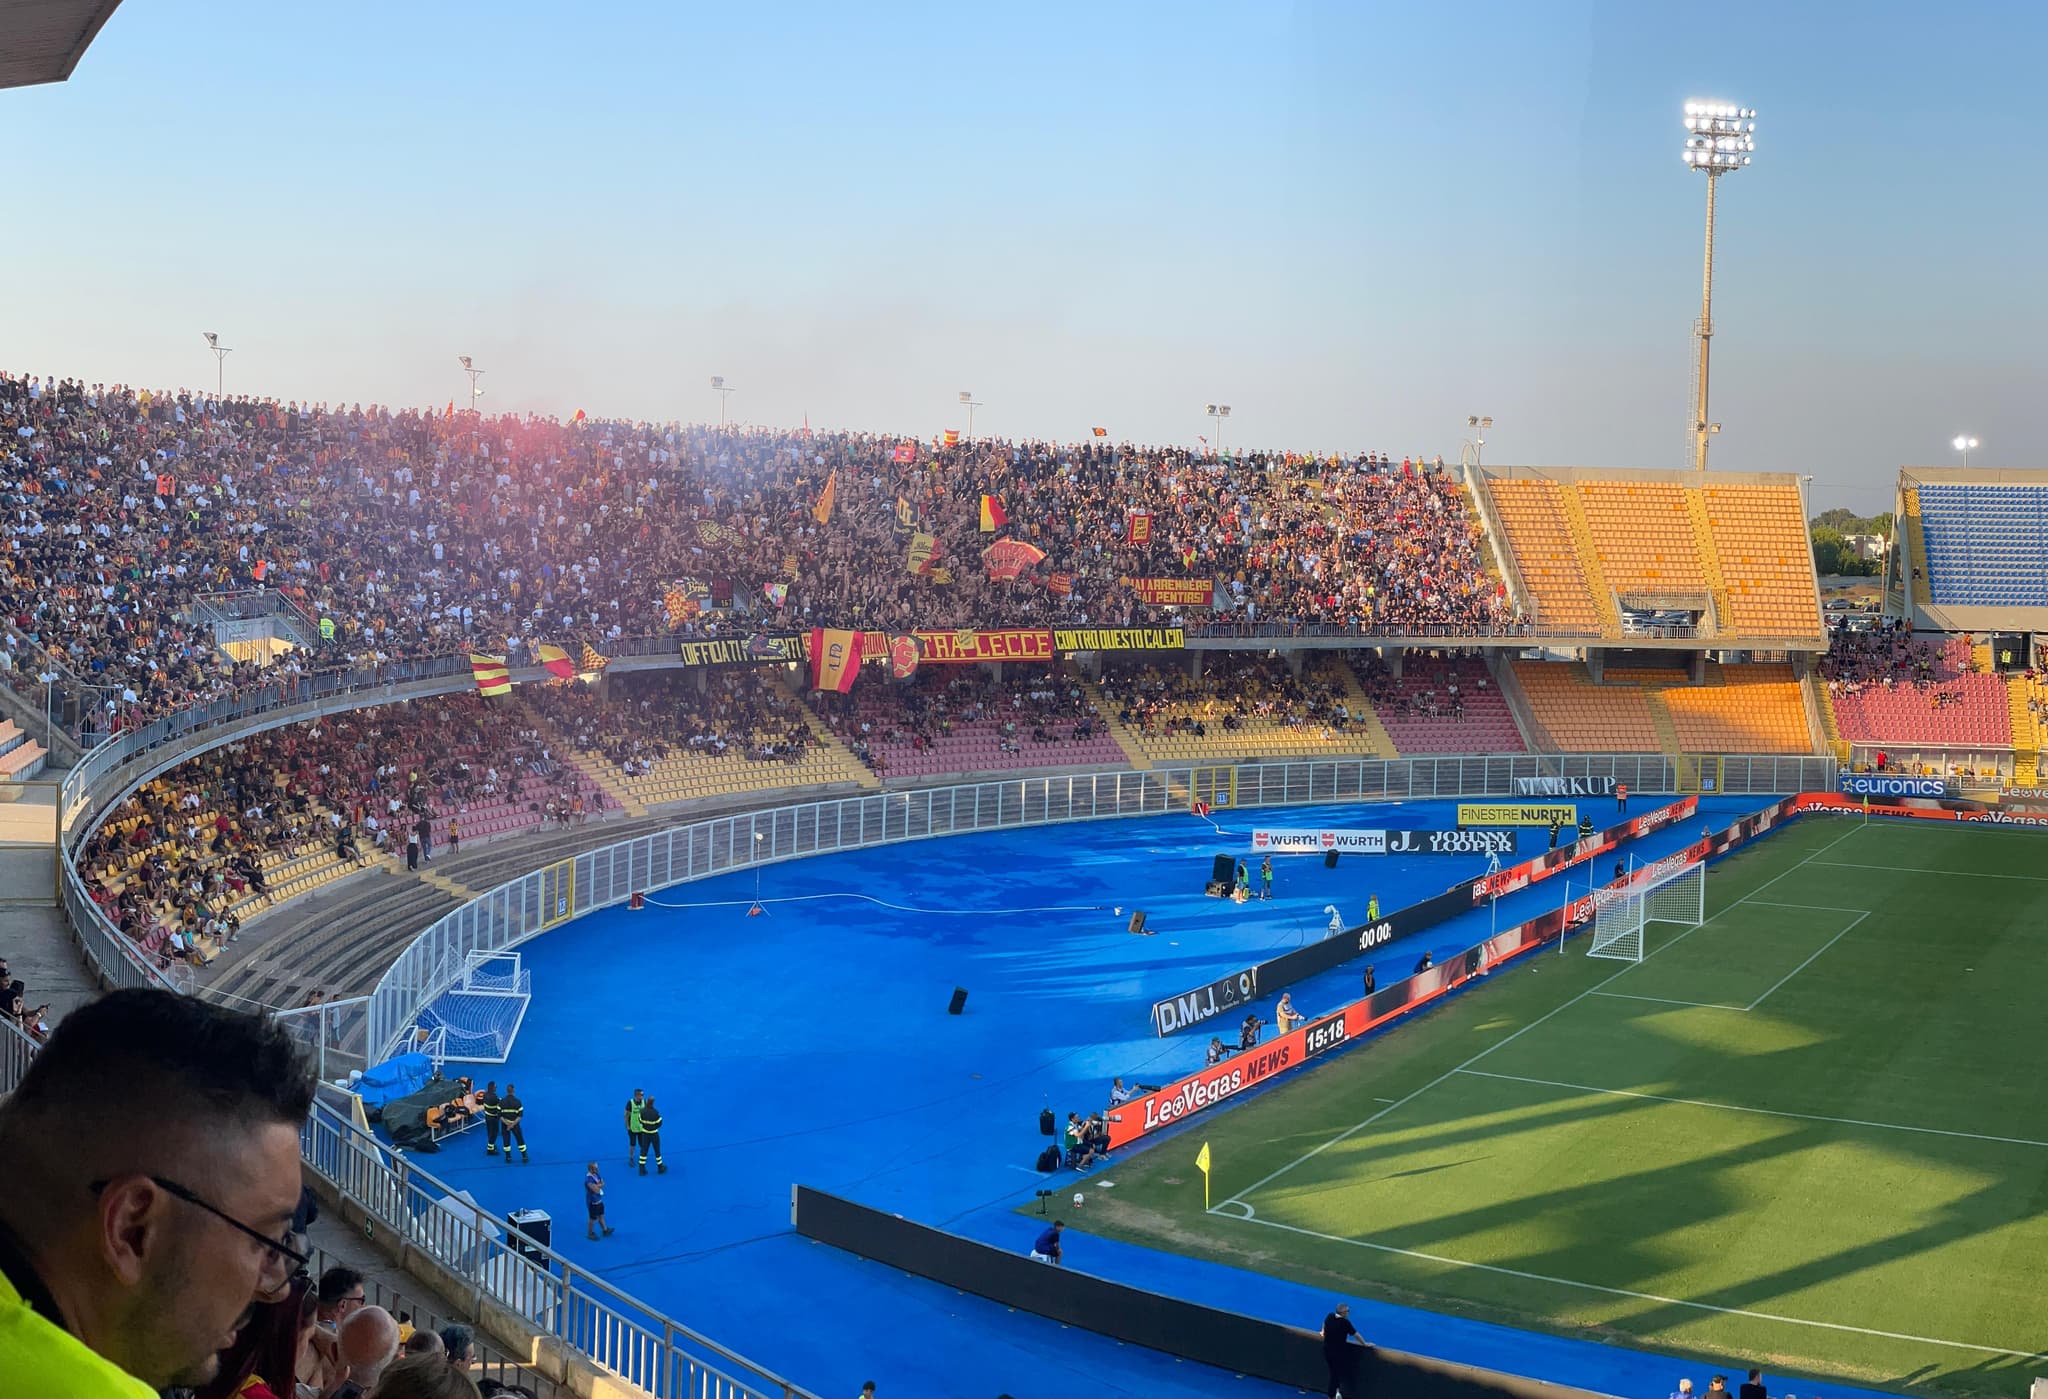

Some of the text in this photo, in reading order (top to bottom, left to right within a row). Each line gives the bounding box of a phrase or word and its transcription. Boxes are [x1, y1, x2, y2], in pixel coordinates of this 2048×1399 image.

[1156, 592, 1204, 604] PENTIRSI
[974, 633, 1051, 657] LECCE
[1054, 628, 1185, 650] CONTRO QUESTO CALCIO
[1516, 776, 1617, 795] MARKUP
[1855, 778, 1944, 795] euronics
[1461, 808, 1572, 821] FINESTRE NURITH
[1270, 834, 1383, 846] WÜRTH WÜRTH
[1429, 831, 1512, 842] JOHNNY
[1431, 841, 1513, 852] LOOPER
[1159, 987, 1219, 1034] D.M.J.
[1307, 1019, 1344, 1051] 15:18
